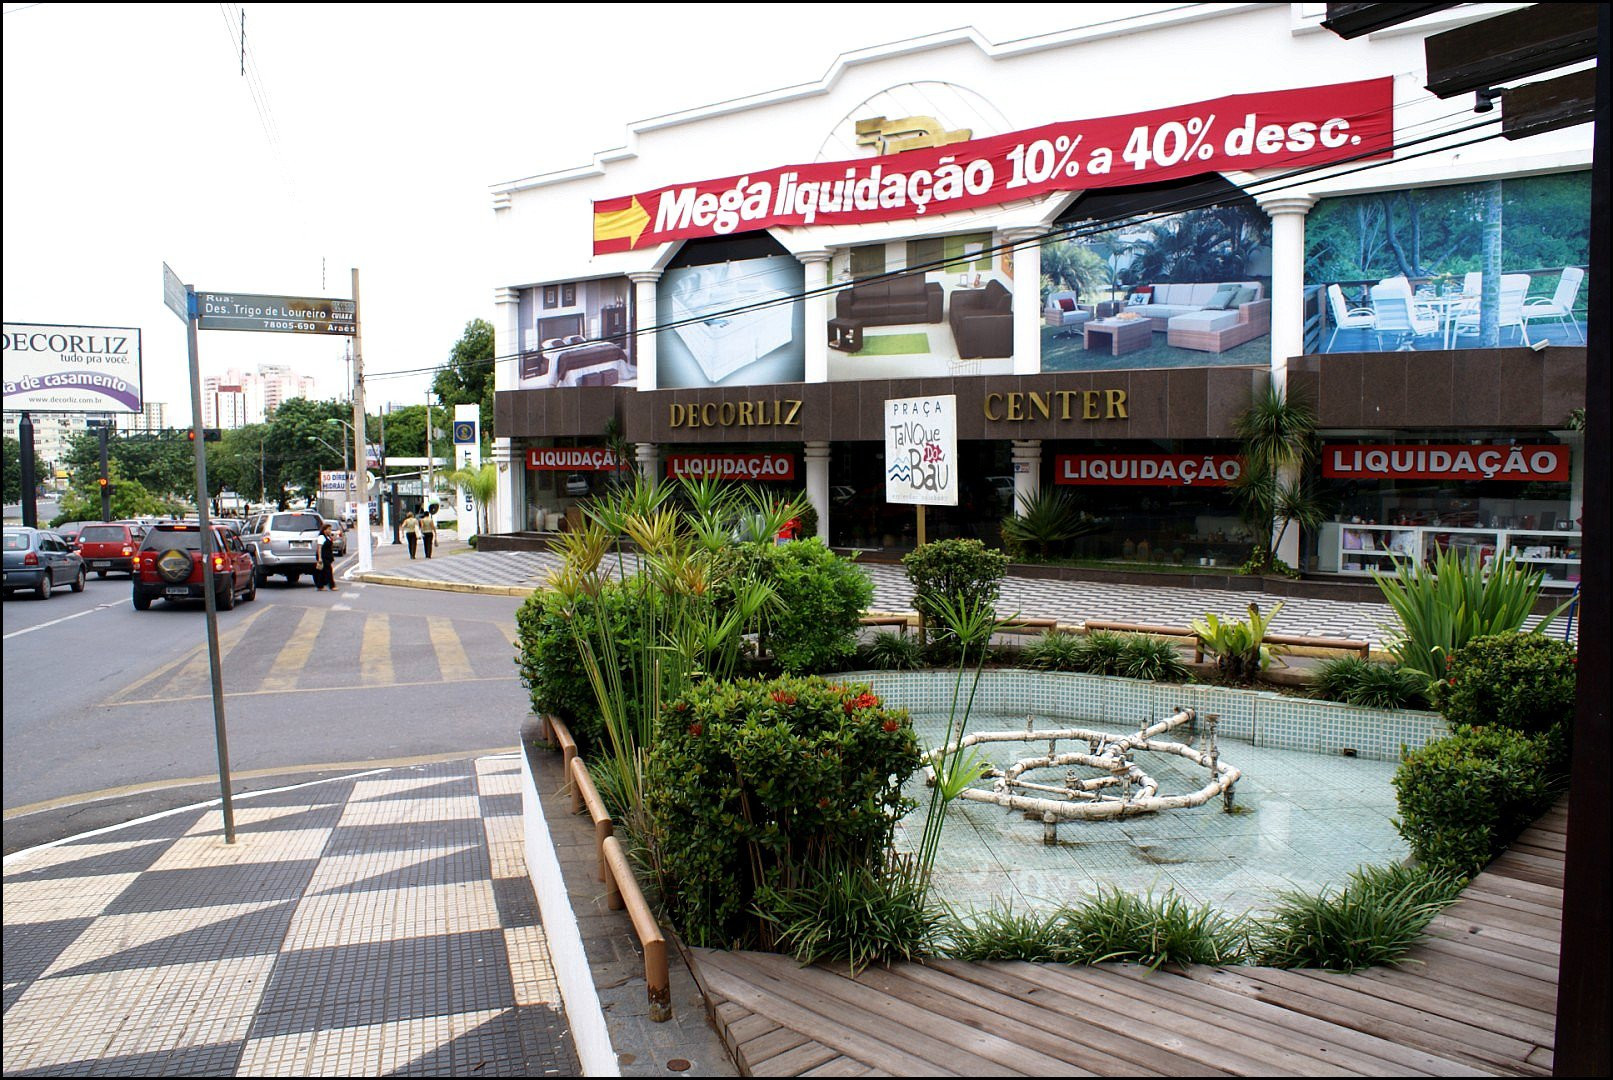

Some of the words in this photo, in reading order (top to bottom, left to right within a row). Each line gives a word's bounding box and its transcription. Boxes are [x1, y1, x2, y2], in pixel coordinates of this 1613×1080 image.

[653, 176, 772, 234] Mega
[772, 156, 994, 224] liquidação
[1005, 134, 1083, 188] 10%
[1087, 146, 1113, 175] a
[1122, 114, 1216, 170] 40%
[1224, 113, 1362, 157] desc.
[206, 295, 234, 303] Rua:
[205, 303, 230, 314] Des.
[234, 304, 261, 318] Trigo
[265, 305, 278, 316] de
[282, 306, 326, 319] Loureiro
[264, 321, 316, 331] 78005-690
[60, 353, 83, 363] tudo
[86, 355, 102, 365] pra
[20, 375, 41, 390] de
[44, 373, 127, 392] casamento
[28, 396, 102, 404] www.decorliz.com.br
[893, 401, 942, 417] PRAÇA
[983, 389, 1129, 421] CENTER
[669, 399, 803, 428] DECORLIZ
[673, 455, 789, 478] LIQUIDAÇÃO
[1064, 456, 1241, 485] LIQUIDAÇÃO
[1334, 446, 1558, 479] LIQUIDAÇÃO
